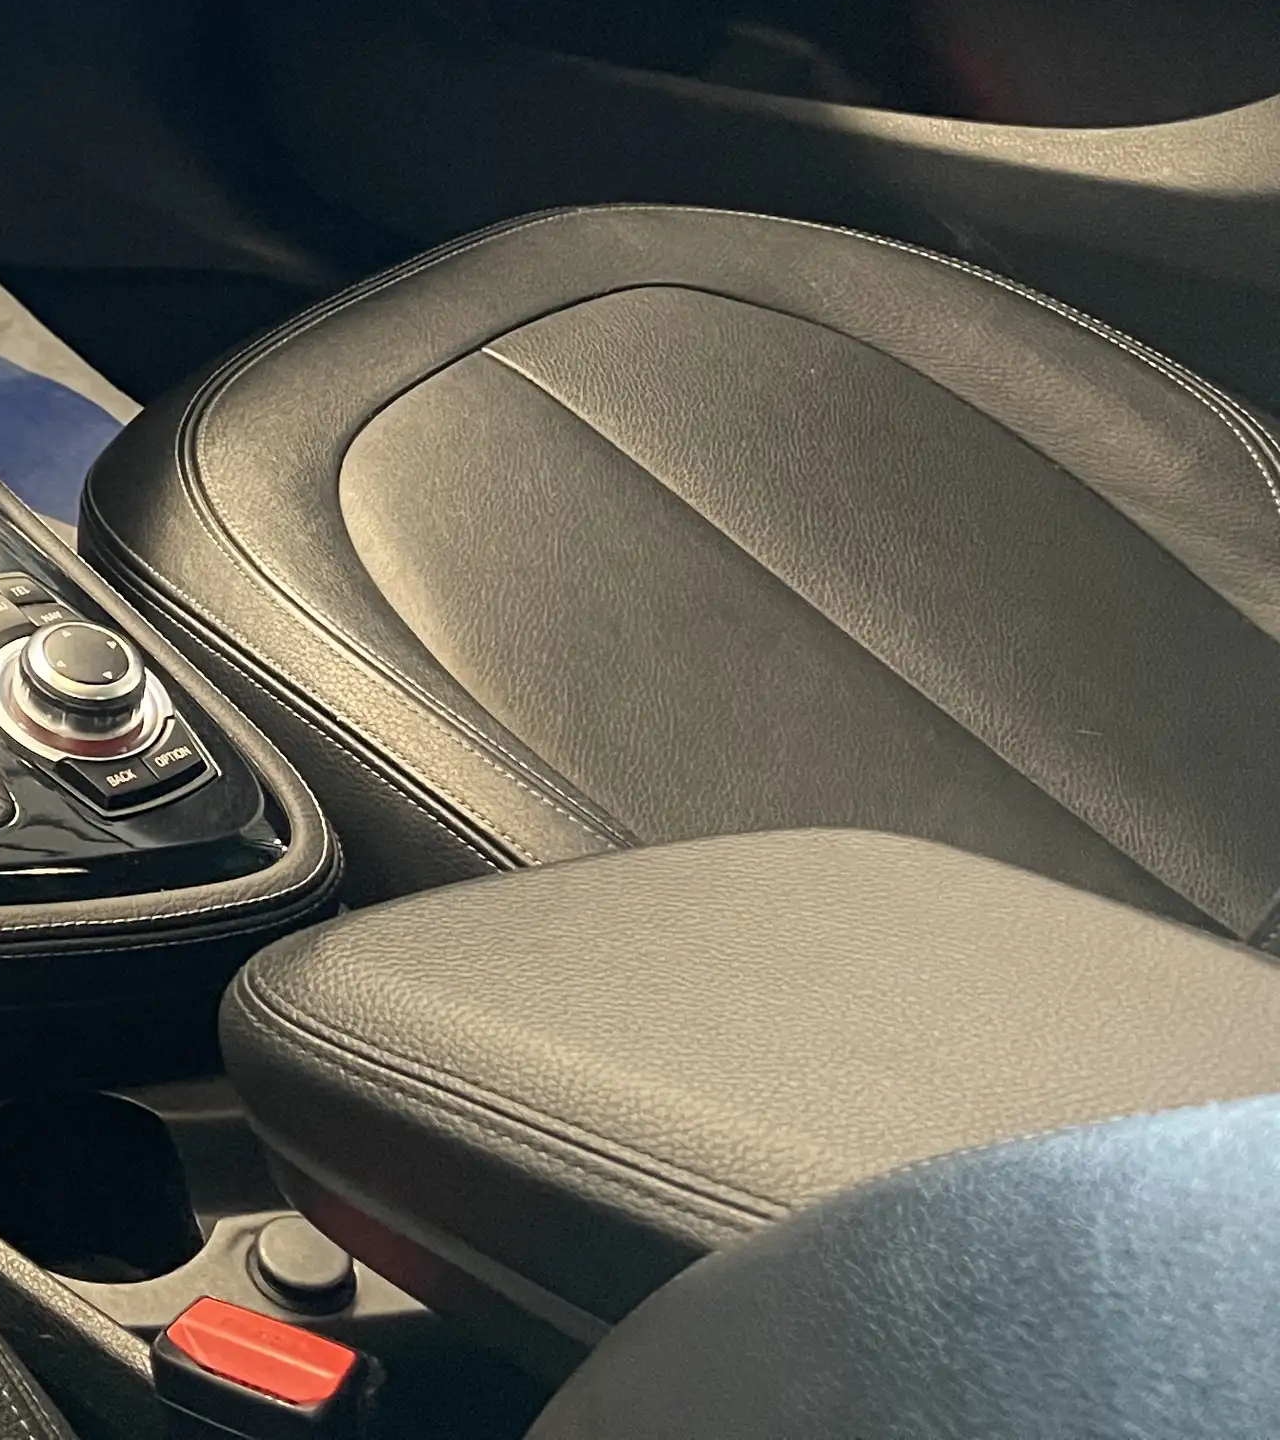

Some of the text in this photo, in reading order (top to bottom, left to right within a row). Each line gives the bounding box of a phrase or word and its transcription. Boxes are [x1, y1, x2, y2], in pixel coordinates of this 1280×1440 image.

[9, 585, 31, 597] TEL
[40, 610, 63, 623] NAV
[154, 745, 193, 768] OPTION
[106, 768, 138, 788] BACK
